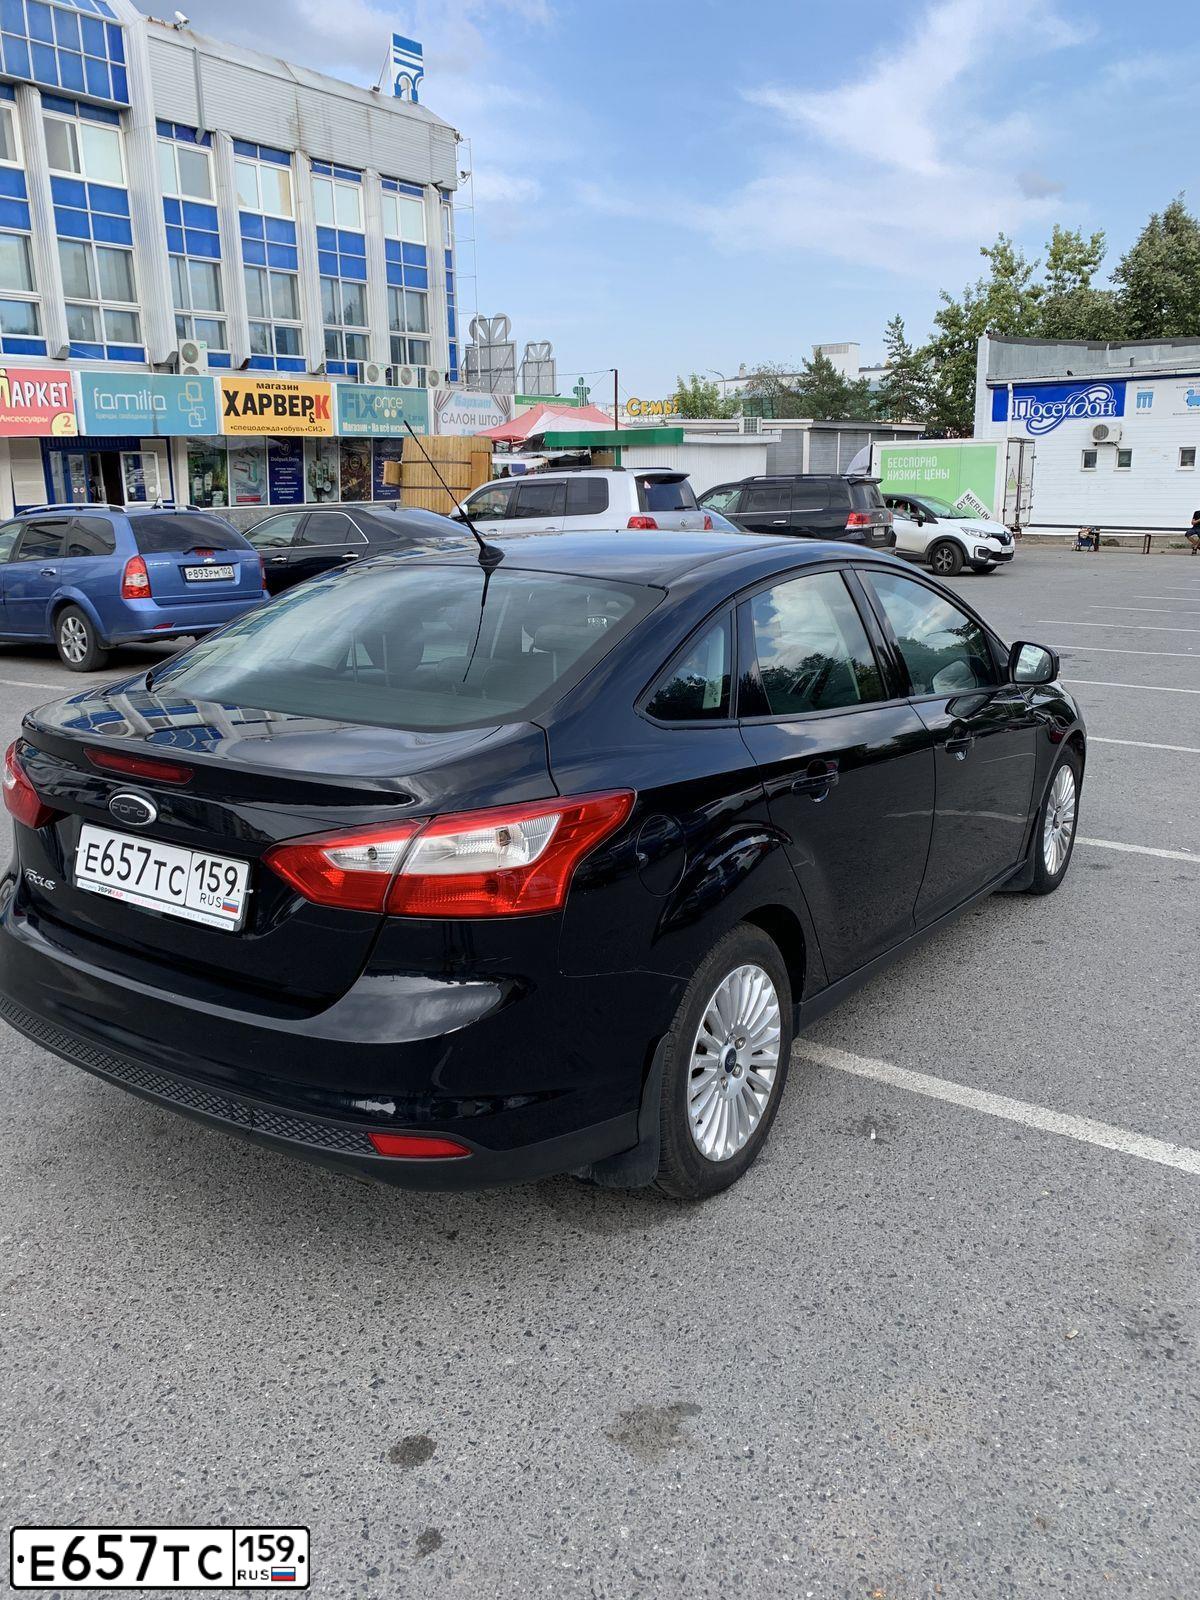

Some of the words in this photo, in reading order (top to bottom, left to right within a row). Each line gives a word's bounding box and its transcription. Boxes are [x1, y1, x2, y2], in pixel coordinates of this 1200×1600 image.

[256, 382, 299, 391] магазин
[93, 387, 167, 411] familia
[63, 415, 71, 427] 2
[441, 411, 476, 425] САЛОН
[478, 414, 504, 426] ШТОР
[887, 455, 938, 468] БЕССПОРНО
[887, 469, 921, 480] НИЗКИЕ
[924, 468, 950, 481] ЦЕНЫ
[964, 493, 991, 520] MERLIN
[84, 839, 186, 896] Е657ТС
[194, 859, 239, 897] 159
[199, 892, 222, 909] RUS
